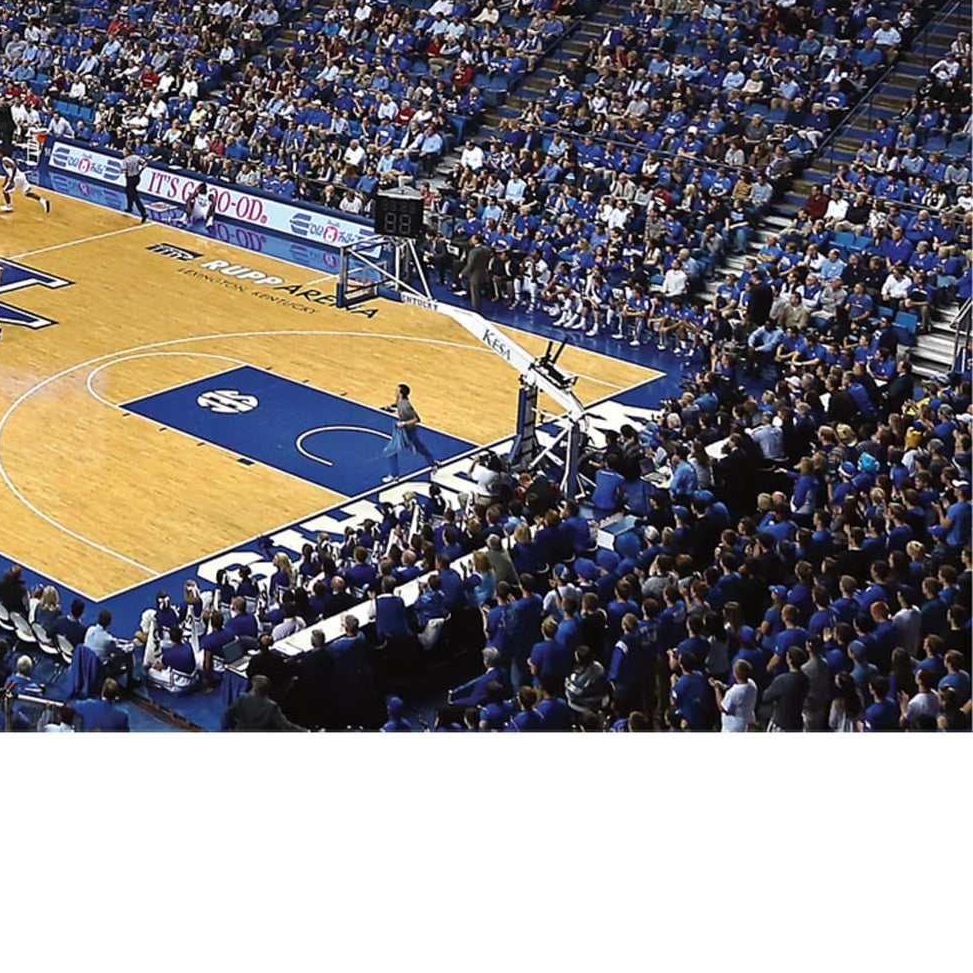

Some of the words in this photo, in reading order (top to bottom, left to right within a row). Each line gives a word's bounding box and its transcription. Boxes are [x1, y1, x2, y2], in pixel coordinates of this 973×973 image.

[148, 171, 179, 198] IT'S
[200, 258, 285, 296] RUPP
[482, 329, 511, 361] KESA
